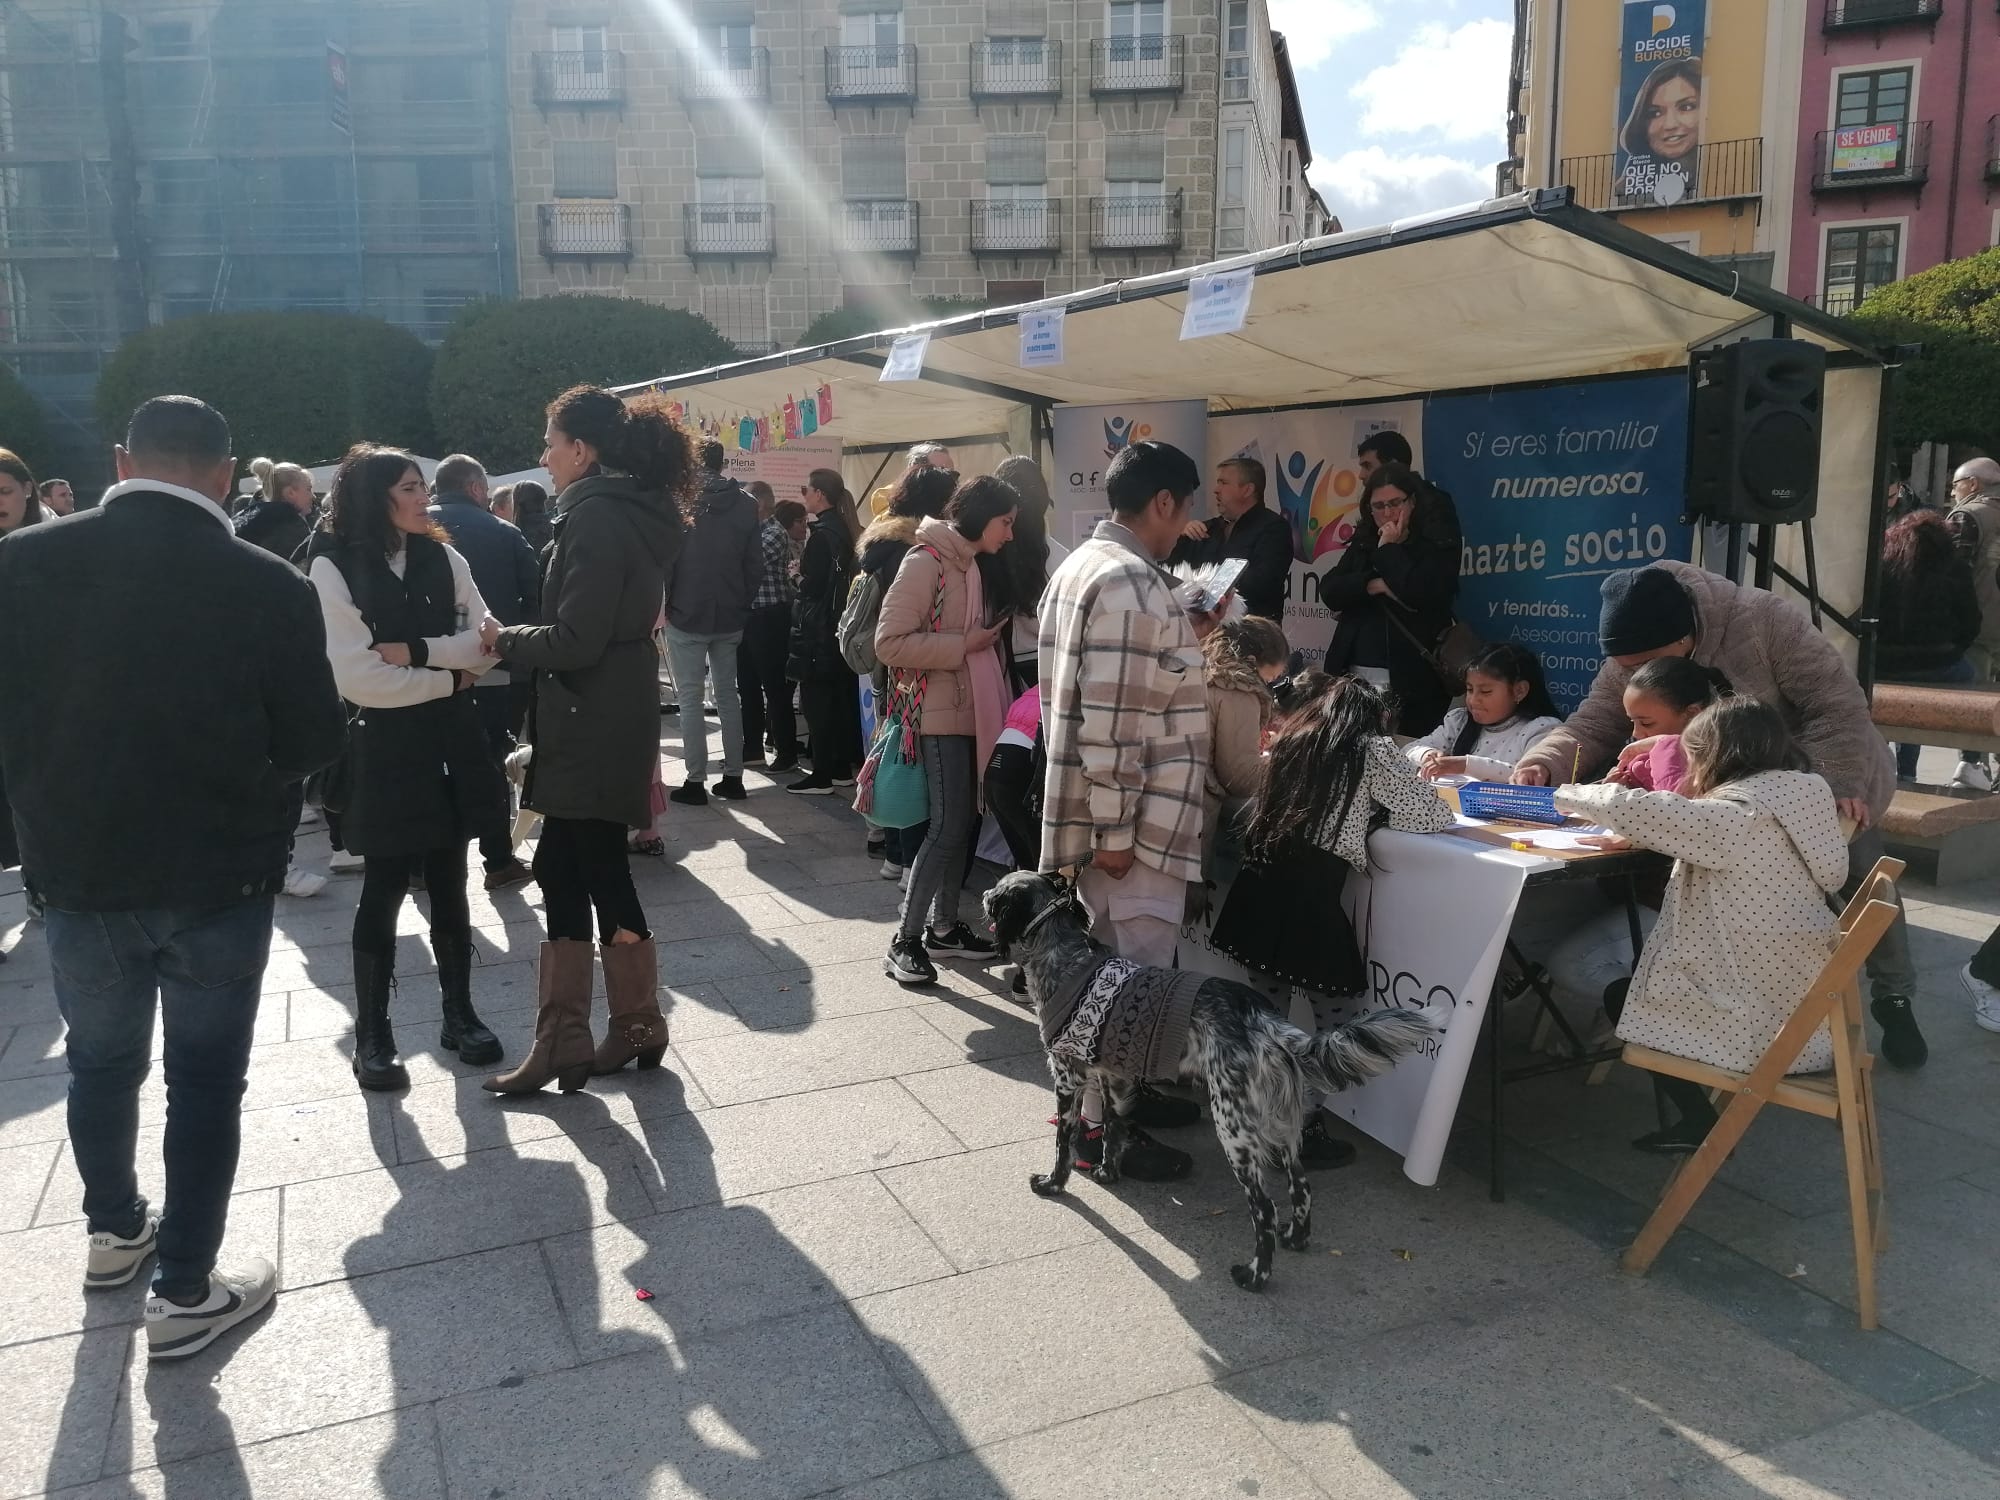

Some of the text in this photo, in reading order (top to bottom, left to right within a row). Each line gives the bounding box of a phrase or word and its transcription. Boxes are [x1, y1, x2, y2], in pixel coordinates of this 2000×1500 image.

[1635, 35, 1691, 52] DECIDE
[1634, 47, 1692, 62] BURGOS
[1841, 127, 1892, 146] SE VENDE
[1625, 162, 1682, 177] QUE NO
[1625, 172, 1689, 187] DECIN
[1463, 420, 1660, 458] Si eres familia
[730, 458, 756, 467] Plena
[1491, 471, 1650, 499] numerosa,
[1459, 512, 1667, 577] hazte socio
[1488, 601, 1500, 618] y
